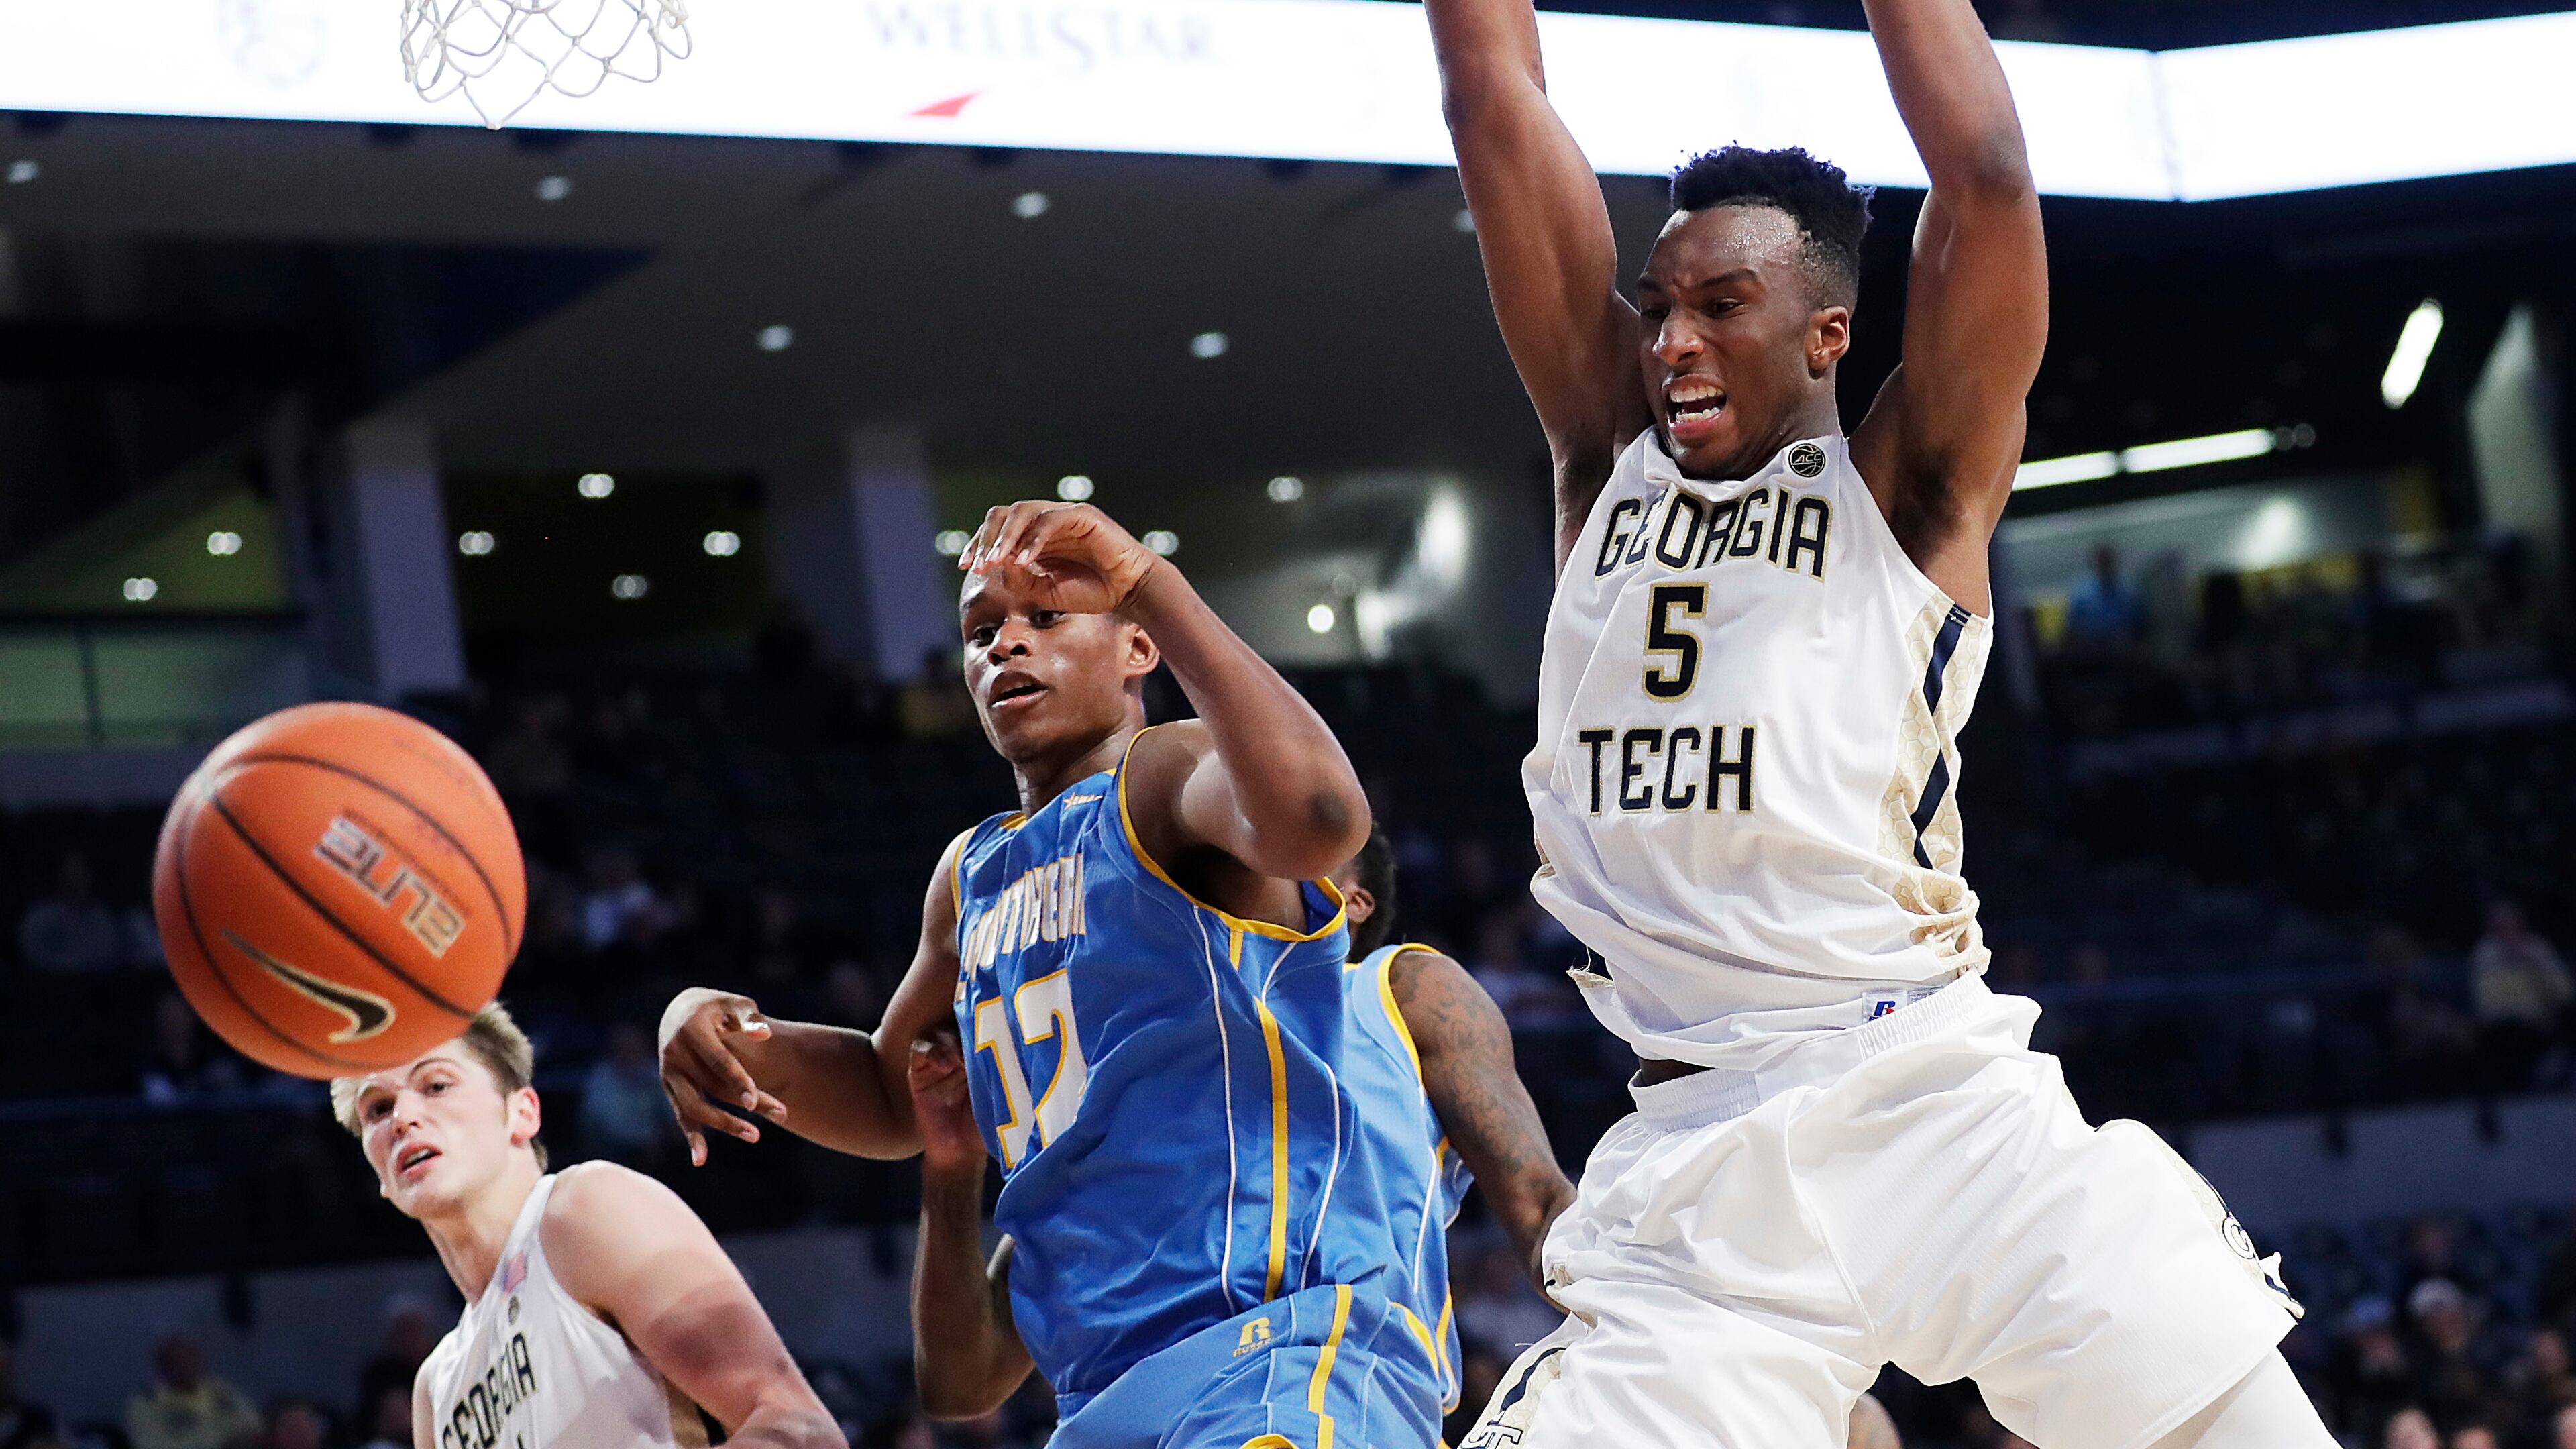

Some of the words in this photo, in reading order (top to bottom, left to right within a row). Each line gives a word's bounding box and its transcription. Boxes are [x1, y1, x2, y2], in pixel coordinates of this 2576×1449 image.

[1794, 453, 1821, 464] ACC
[1595, 486, 1833, 584] GEORGIA
[1642, 580, 1711, 704] 5
[1578, 722, 1758, 817] TECH
[313, 814, 466, 959] ELITE
[955, 853, 1086, 1002] OUTHERN
